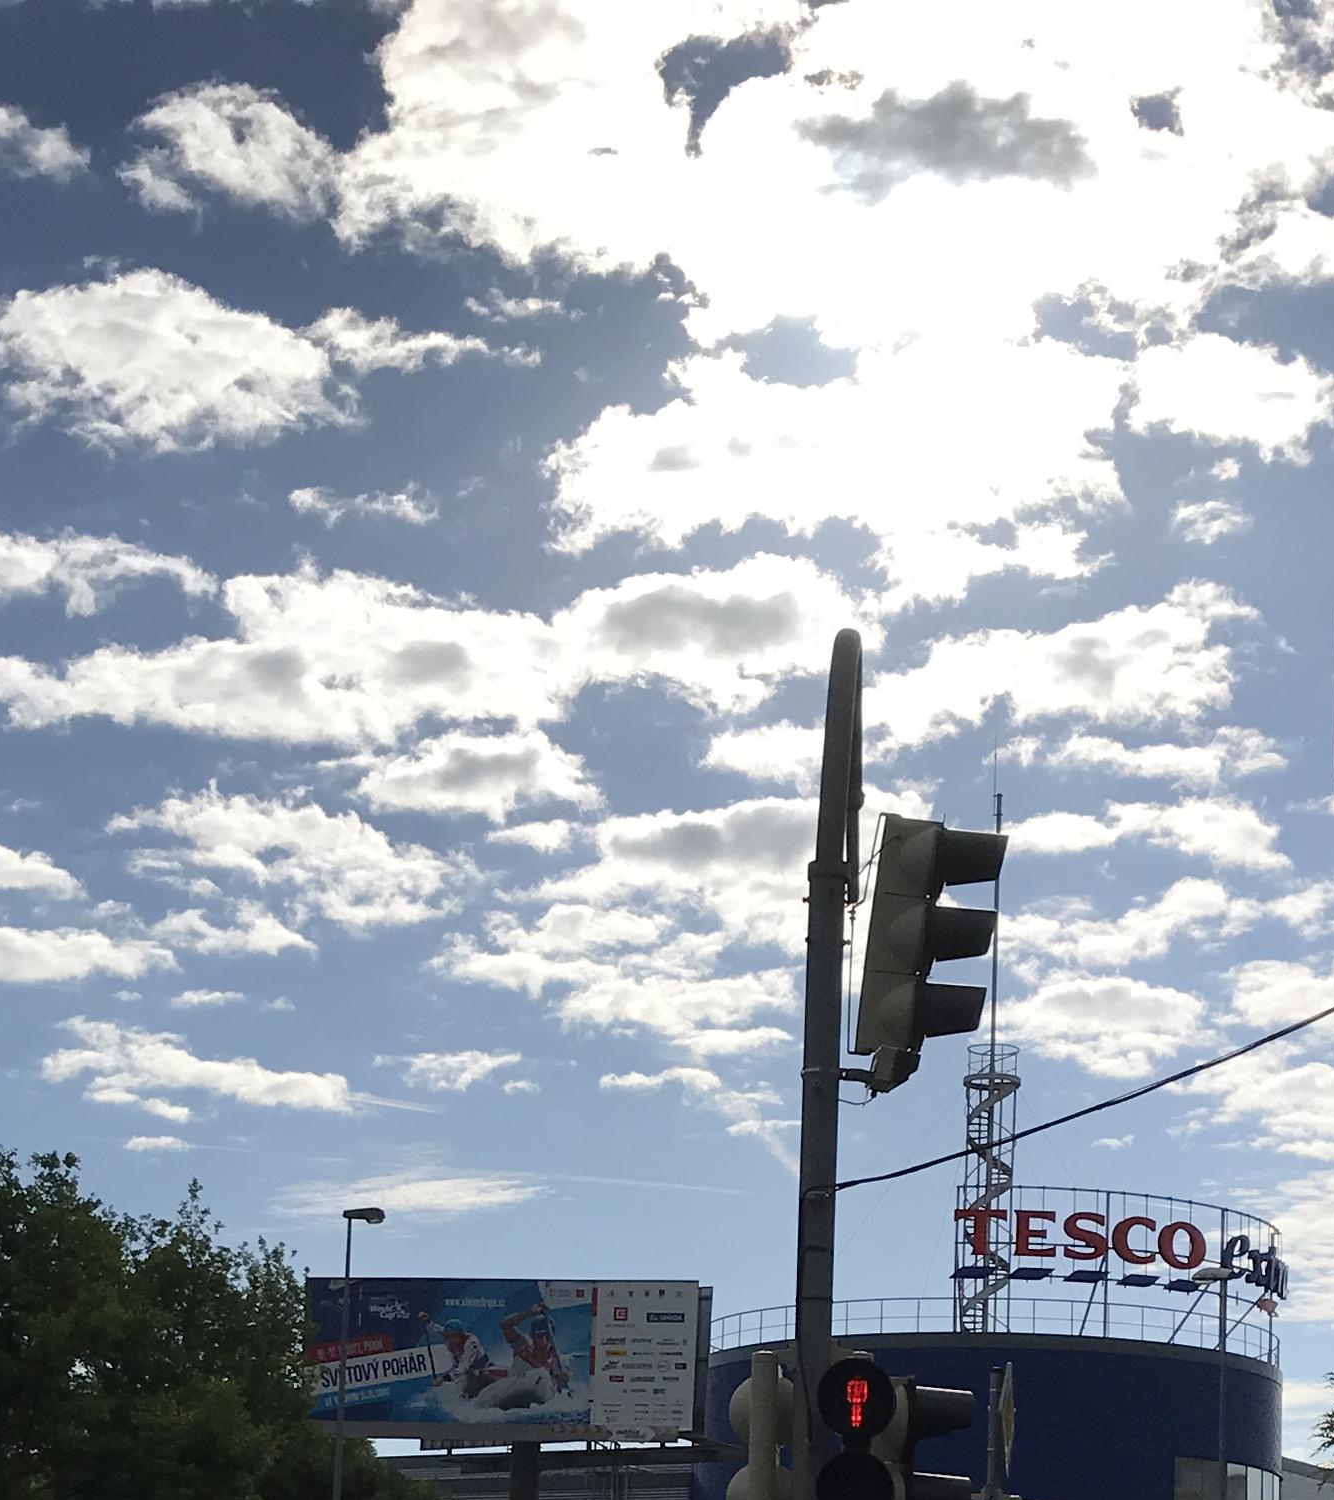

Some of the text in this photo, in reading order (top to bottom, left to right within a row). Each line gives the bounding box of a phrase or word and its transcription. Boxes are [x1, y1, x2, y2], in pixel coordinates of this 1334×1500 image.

[954, 1209, 1207, 1269] TESCO
[321, 1351, 428, 1388] SVTOVÝ POHÁR
